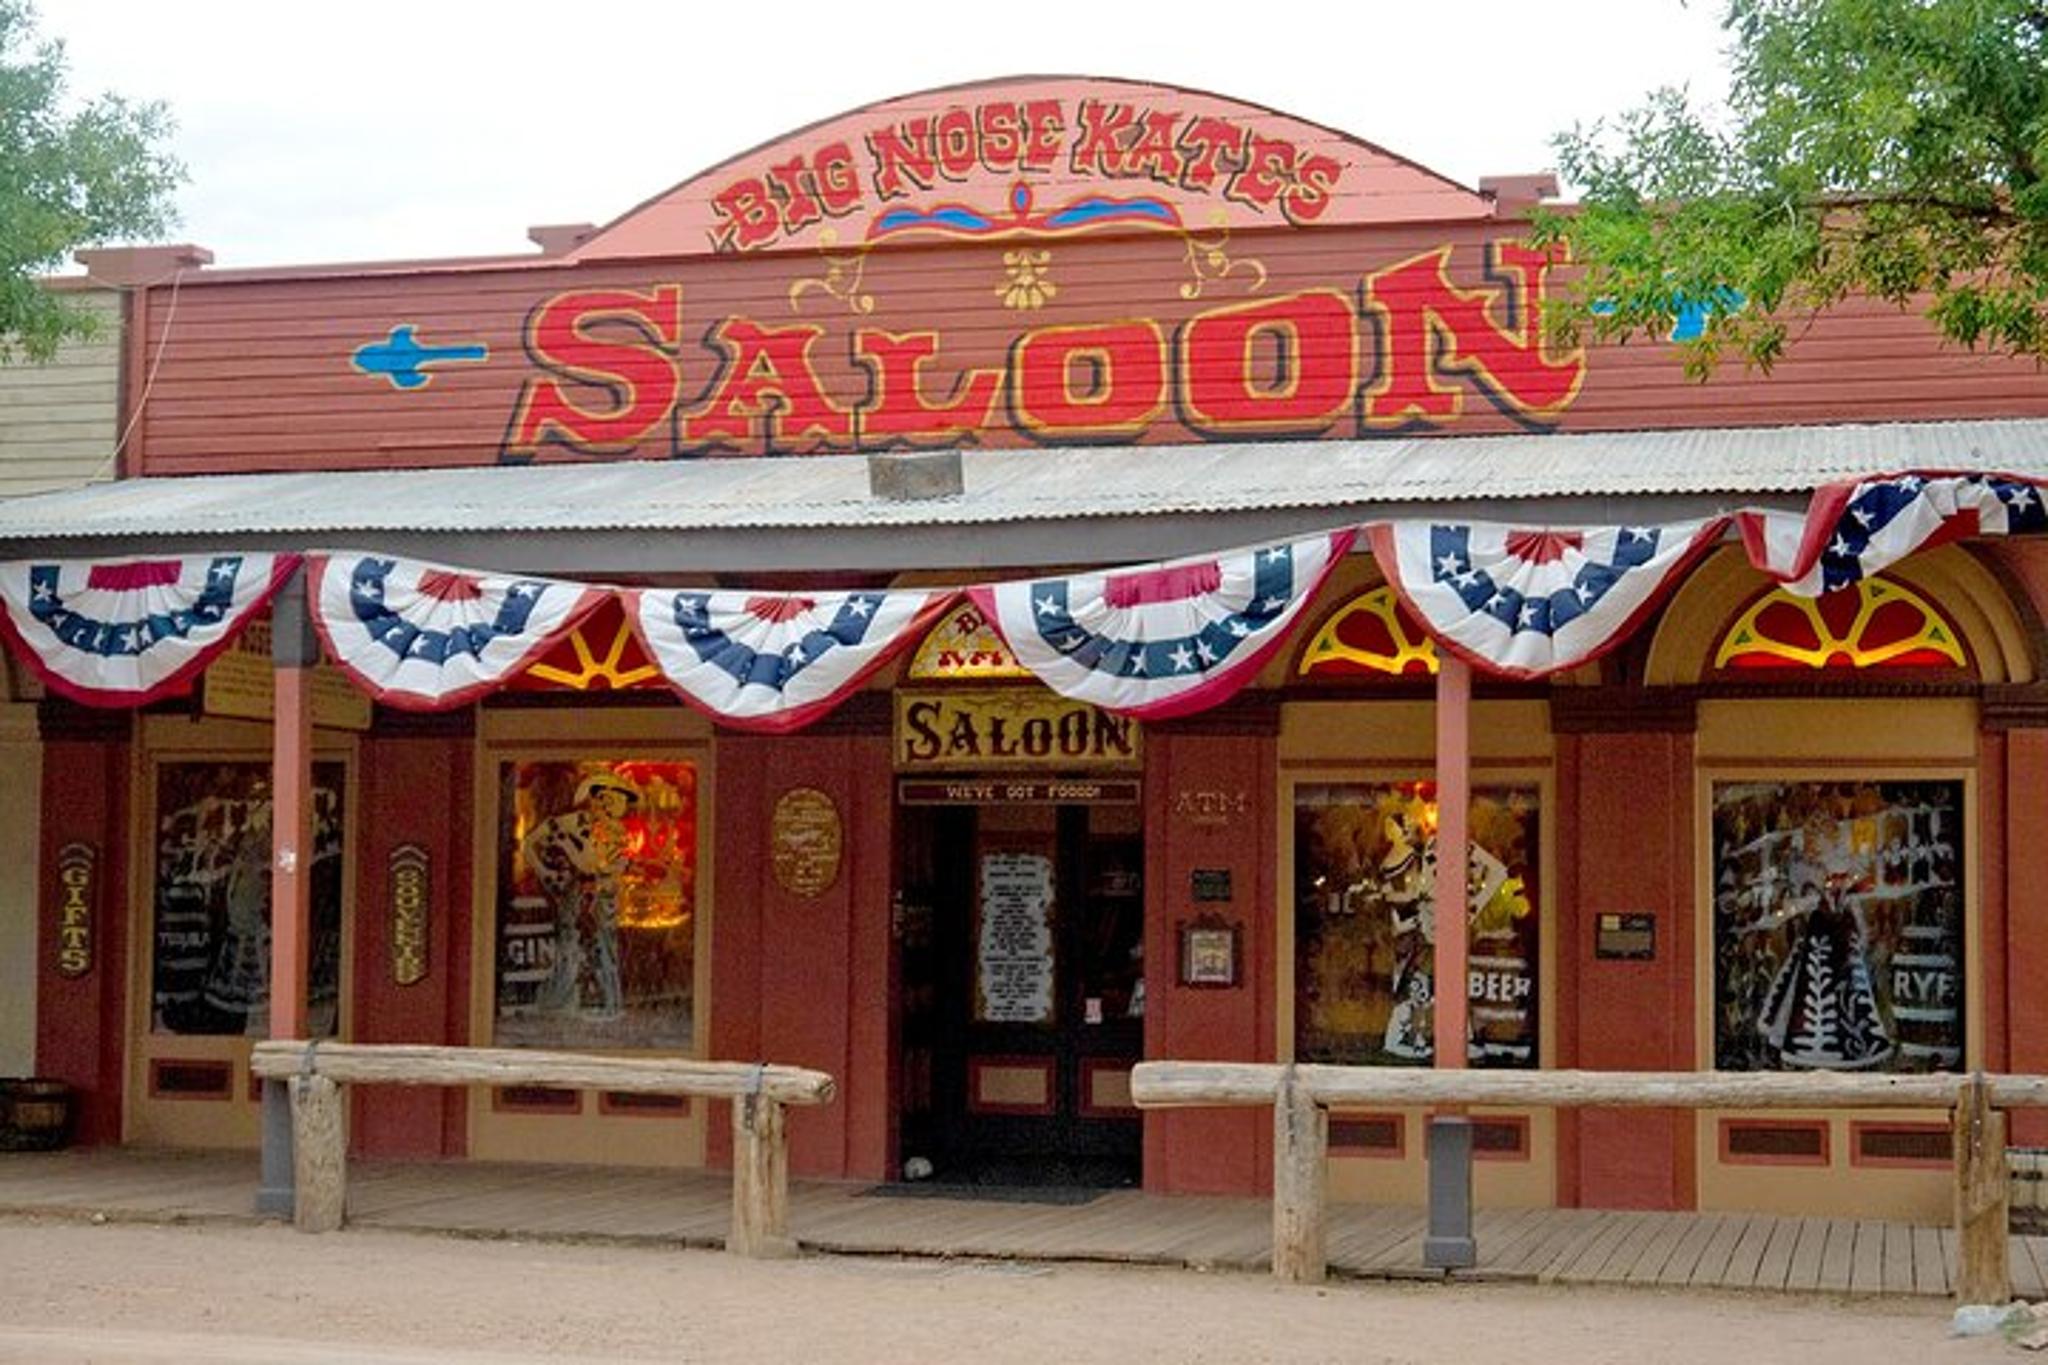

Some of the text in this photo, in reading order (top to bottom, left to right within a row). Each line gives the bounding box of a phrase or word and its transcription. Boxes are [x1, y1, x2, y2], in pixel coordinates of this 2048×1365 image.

[712, 98, 1345, 252] BIG NOSE KATES
[502, 237, 1587, 456] SALOON
[906, 700, 1133, 761] SALOON
[1006, 785, 1034, 800] GOT
[1176, 792, 1246, 813] ATM
[62, 868, 89, 973] GIFTS
[508, 937, 556, 966] GIN
[1467, 972, 1531, 1002] BEER
[1893, 969, 1956, 1001] RYE
